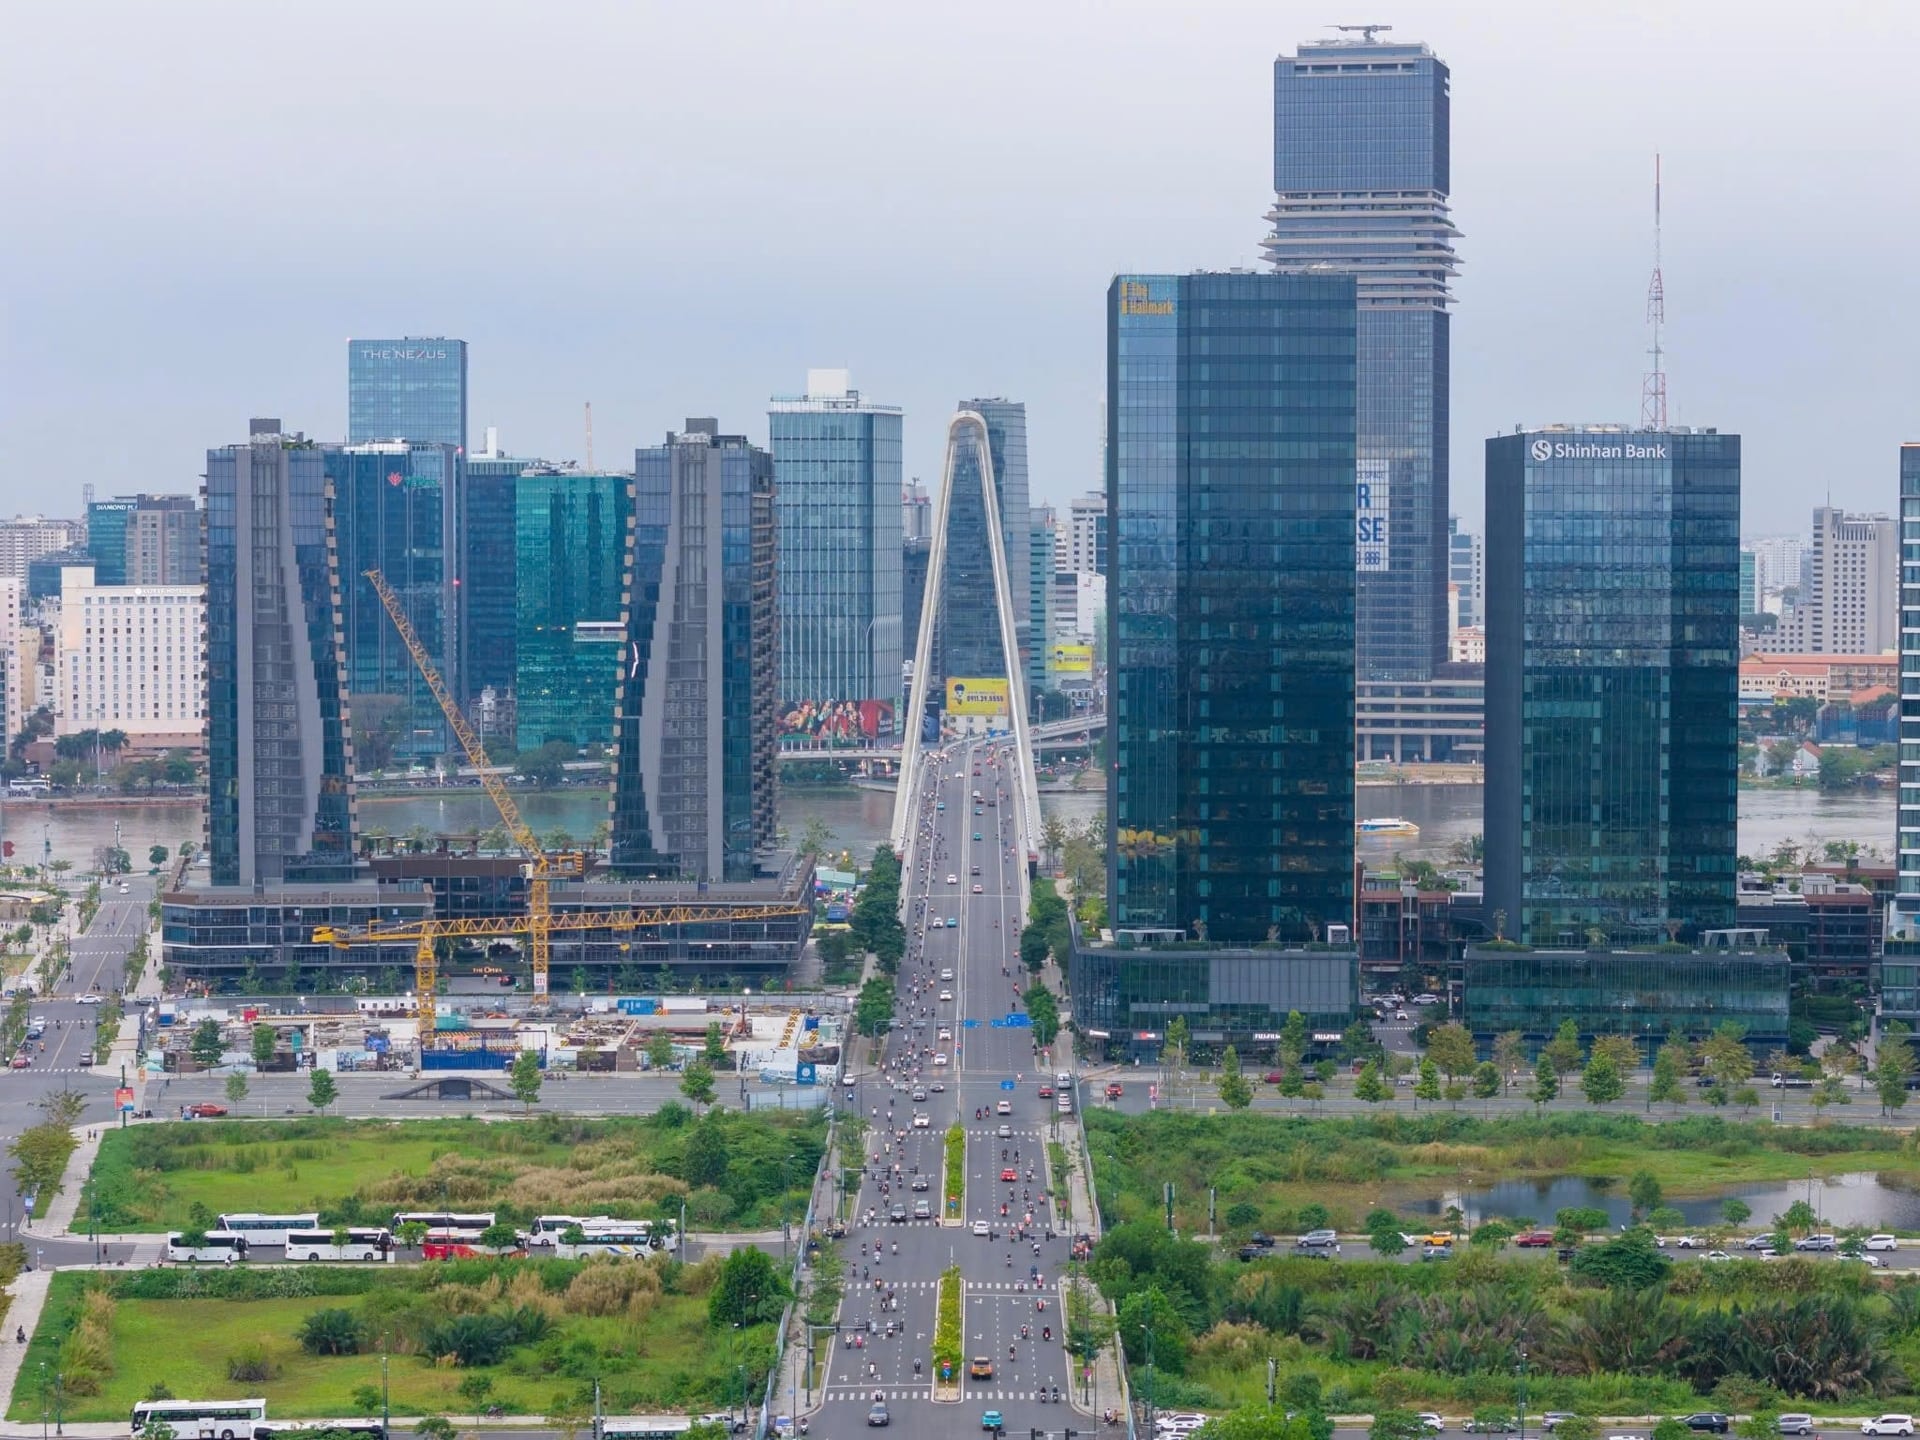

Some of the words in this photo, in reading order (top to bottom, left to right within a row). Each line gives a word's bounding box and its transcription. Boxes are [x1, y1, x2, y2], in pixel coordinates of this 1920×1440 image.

[1130, 299, 1173, 314] Hallmark
[361, 349, 391, 359] THE
[1555, 442, 1622, 458] Shinhan
[1626, 443, 1666, 458] Bank
[1358, 517, 1384, 542] SE
